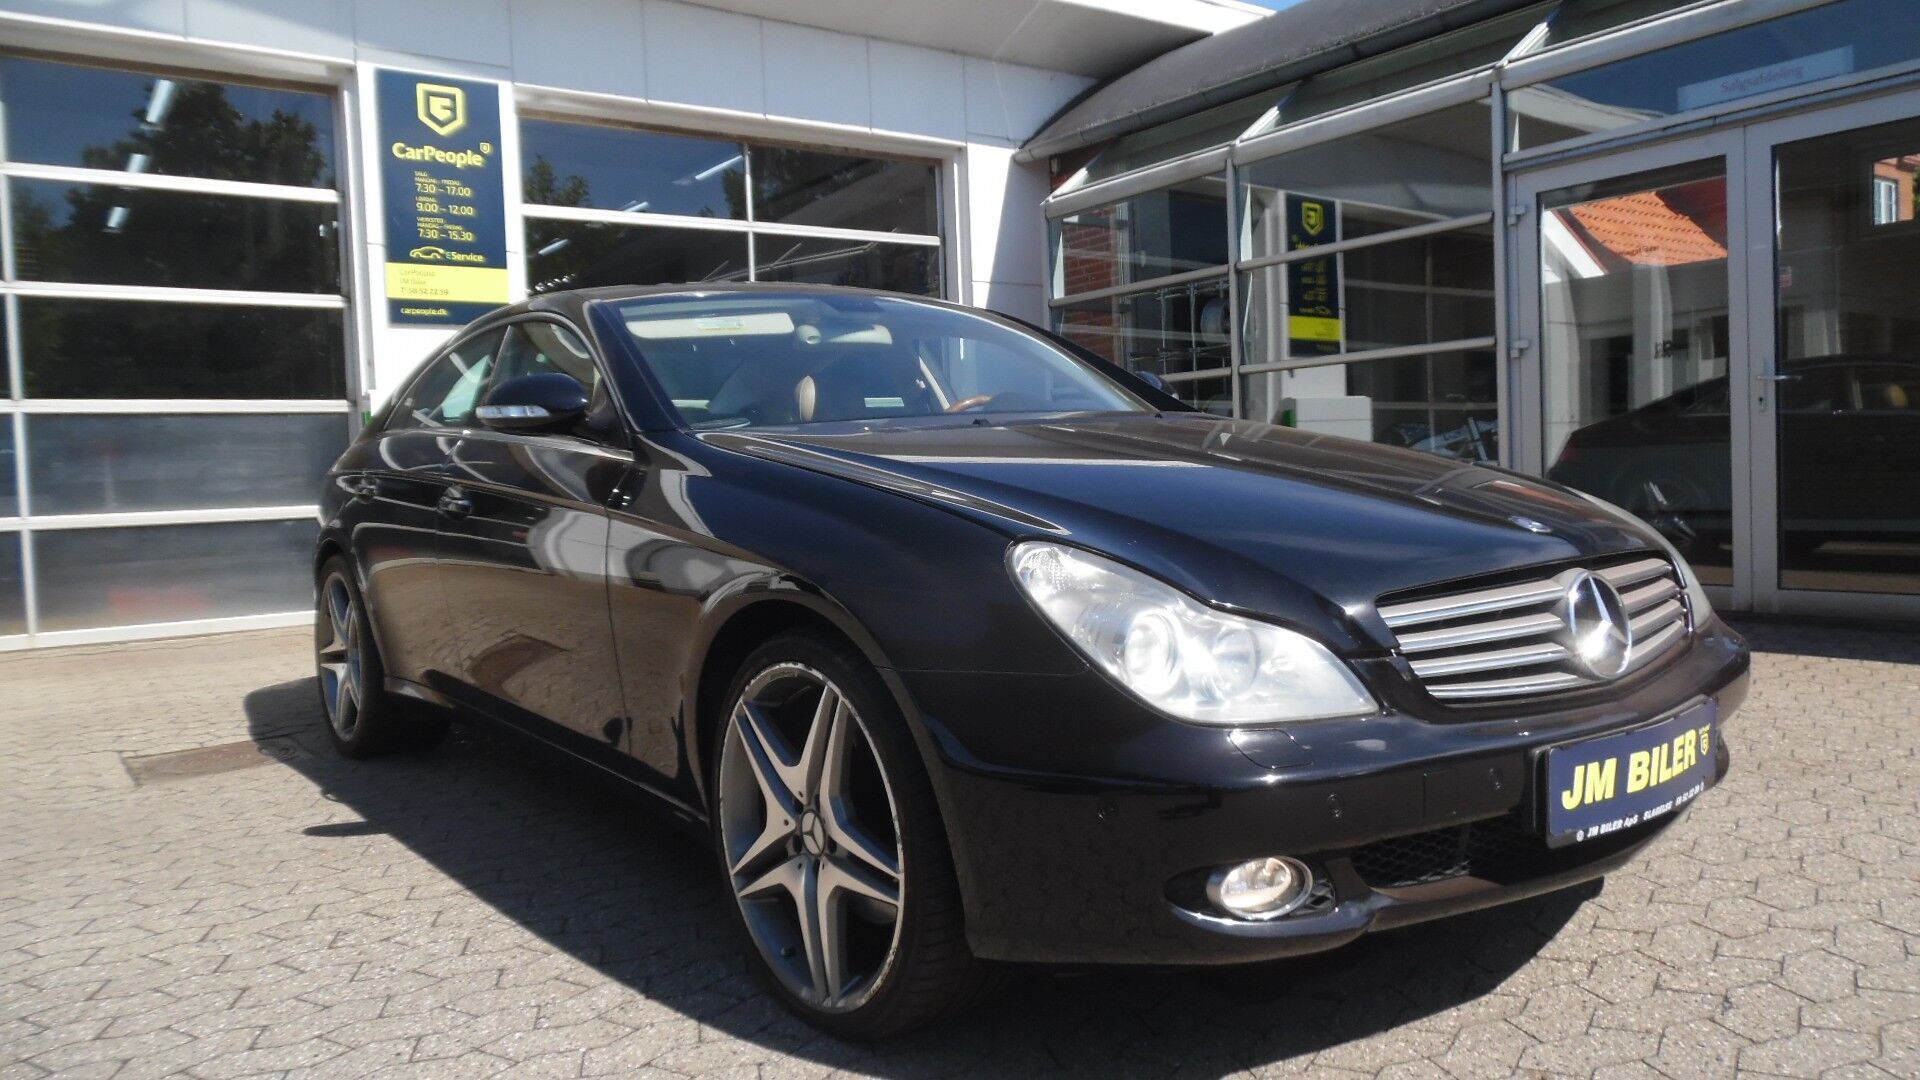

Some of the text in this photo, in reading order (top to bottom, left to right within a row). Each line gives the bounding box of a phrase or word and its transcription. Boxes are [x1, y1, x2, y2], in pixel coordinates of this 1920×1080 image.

[392, 142, 484, 168] CarPeople
[415, 184, 436, 193] 7.30
[446, 186, 471, 197] 17.00
[416, 202, 438, 213] 9.00
[448, 205, 473, 216] 12.00
[419, 228, 438, 239] 7.30
[448, 231, 473, 241] 15.30
[1561, 729, 1696, 810] JM BILER
[1587, 826, 1599, 838] JM
[1600, 818, 1623, 834] BILER
